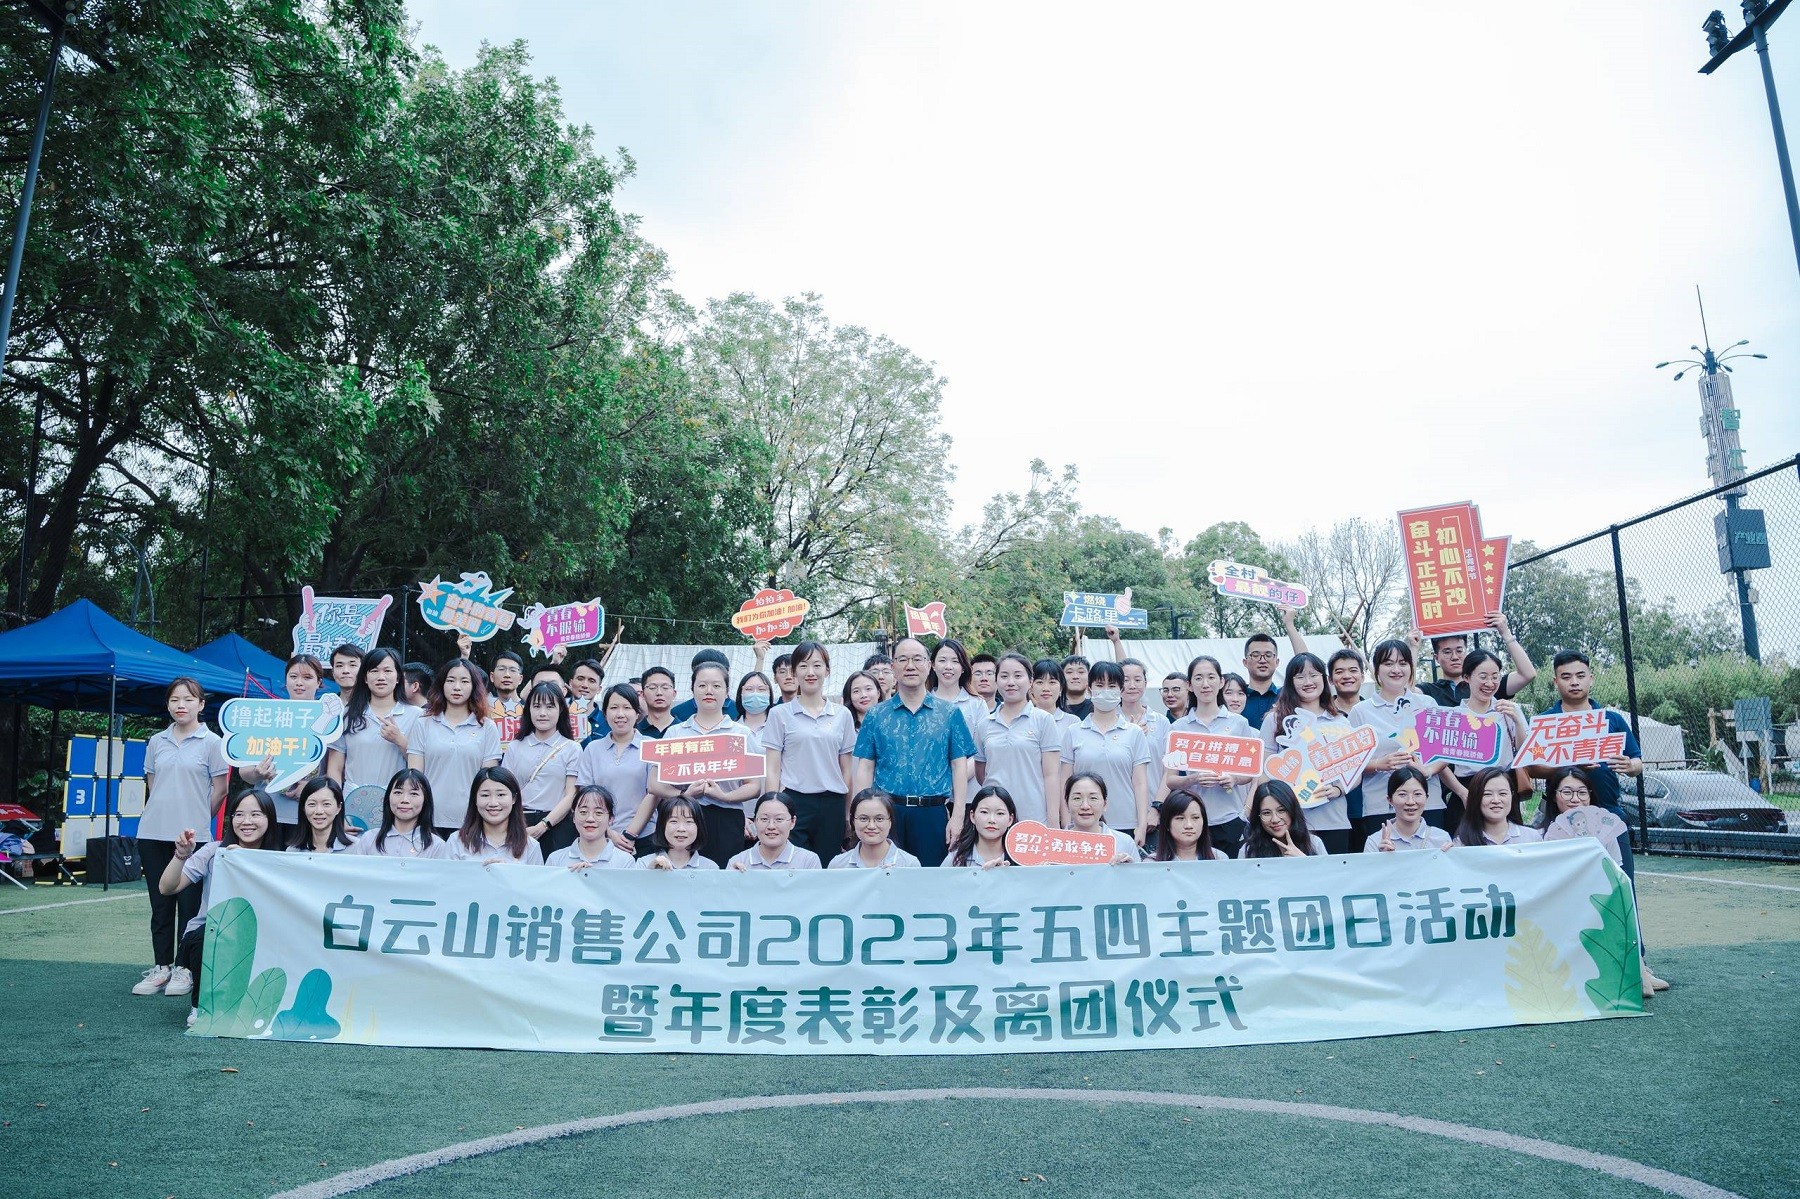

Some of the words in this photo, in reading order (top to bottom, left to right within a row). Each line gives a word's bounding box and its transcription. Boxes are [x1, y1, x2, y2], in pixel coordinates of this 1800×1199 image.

[1225, 565, 1256, 580] 全村
[1408, 520, 1443, 621] 奋斗正当时
[1435, 526, 1468, 607] 初心不改
[755, 593, 785, 607] 拍拍手
[1234, 580, 1299, 603] 最靓的仔
[317, 602, 362, 630] 你是
[546, 606, 574, 623] 青春
[1069, 605, 1119, 623] 卡路里
[546, 619, 587, 637] 不服输
[755, 620, 790, 636] 加加油
[231, 706, 315, 729] 撸起袖子
[1425, 707, 1462, 729] 青春
[1423, 725, 1478, 750] 不服输
[1519, 711, 1608, 753] 无奋斗
[245, 735, 308, 757] 加油干!
[654, 739, 715, 757] 年青有志
[1175, 738, 1240, 754] 努力拼搏
[1310, 728, 1373, 770] 青春万岁
[1545, 735, 1625, 764] 不青春
[677, 758, 738, 777] 不负年华
[1188, 752, 1253, 768] 自强不息
[75, 789, 86, 805] 3
[1015, 832, 1043, 844] 努力
[1051, 838, 1109, 857] 勇敢争先
[1014, 843, 1041, 855] 奋斗
[323, 884, 1516, 967] 白云山销售公司2023年五四主题团日活动
[599, 975, 1248, 1045] 暨年度表彰及离团仪式
